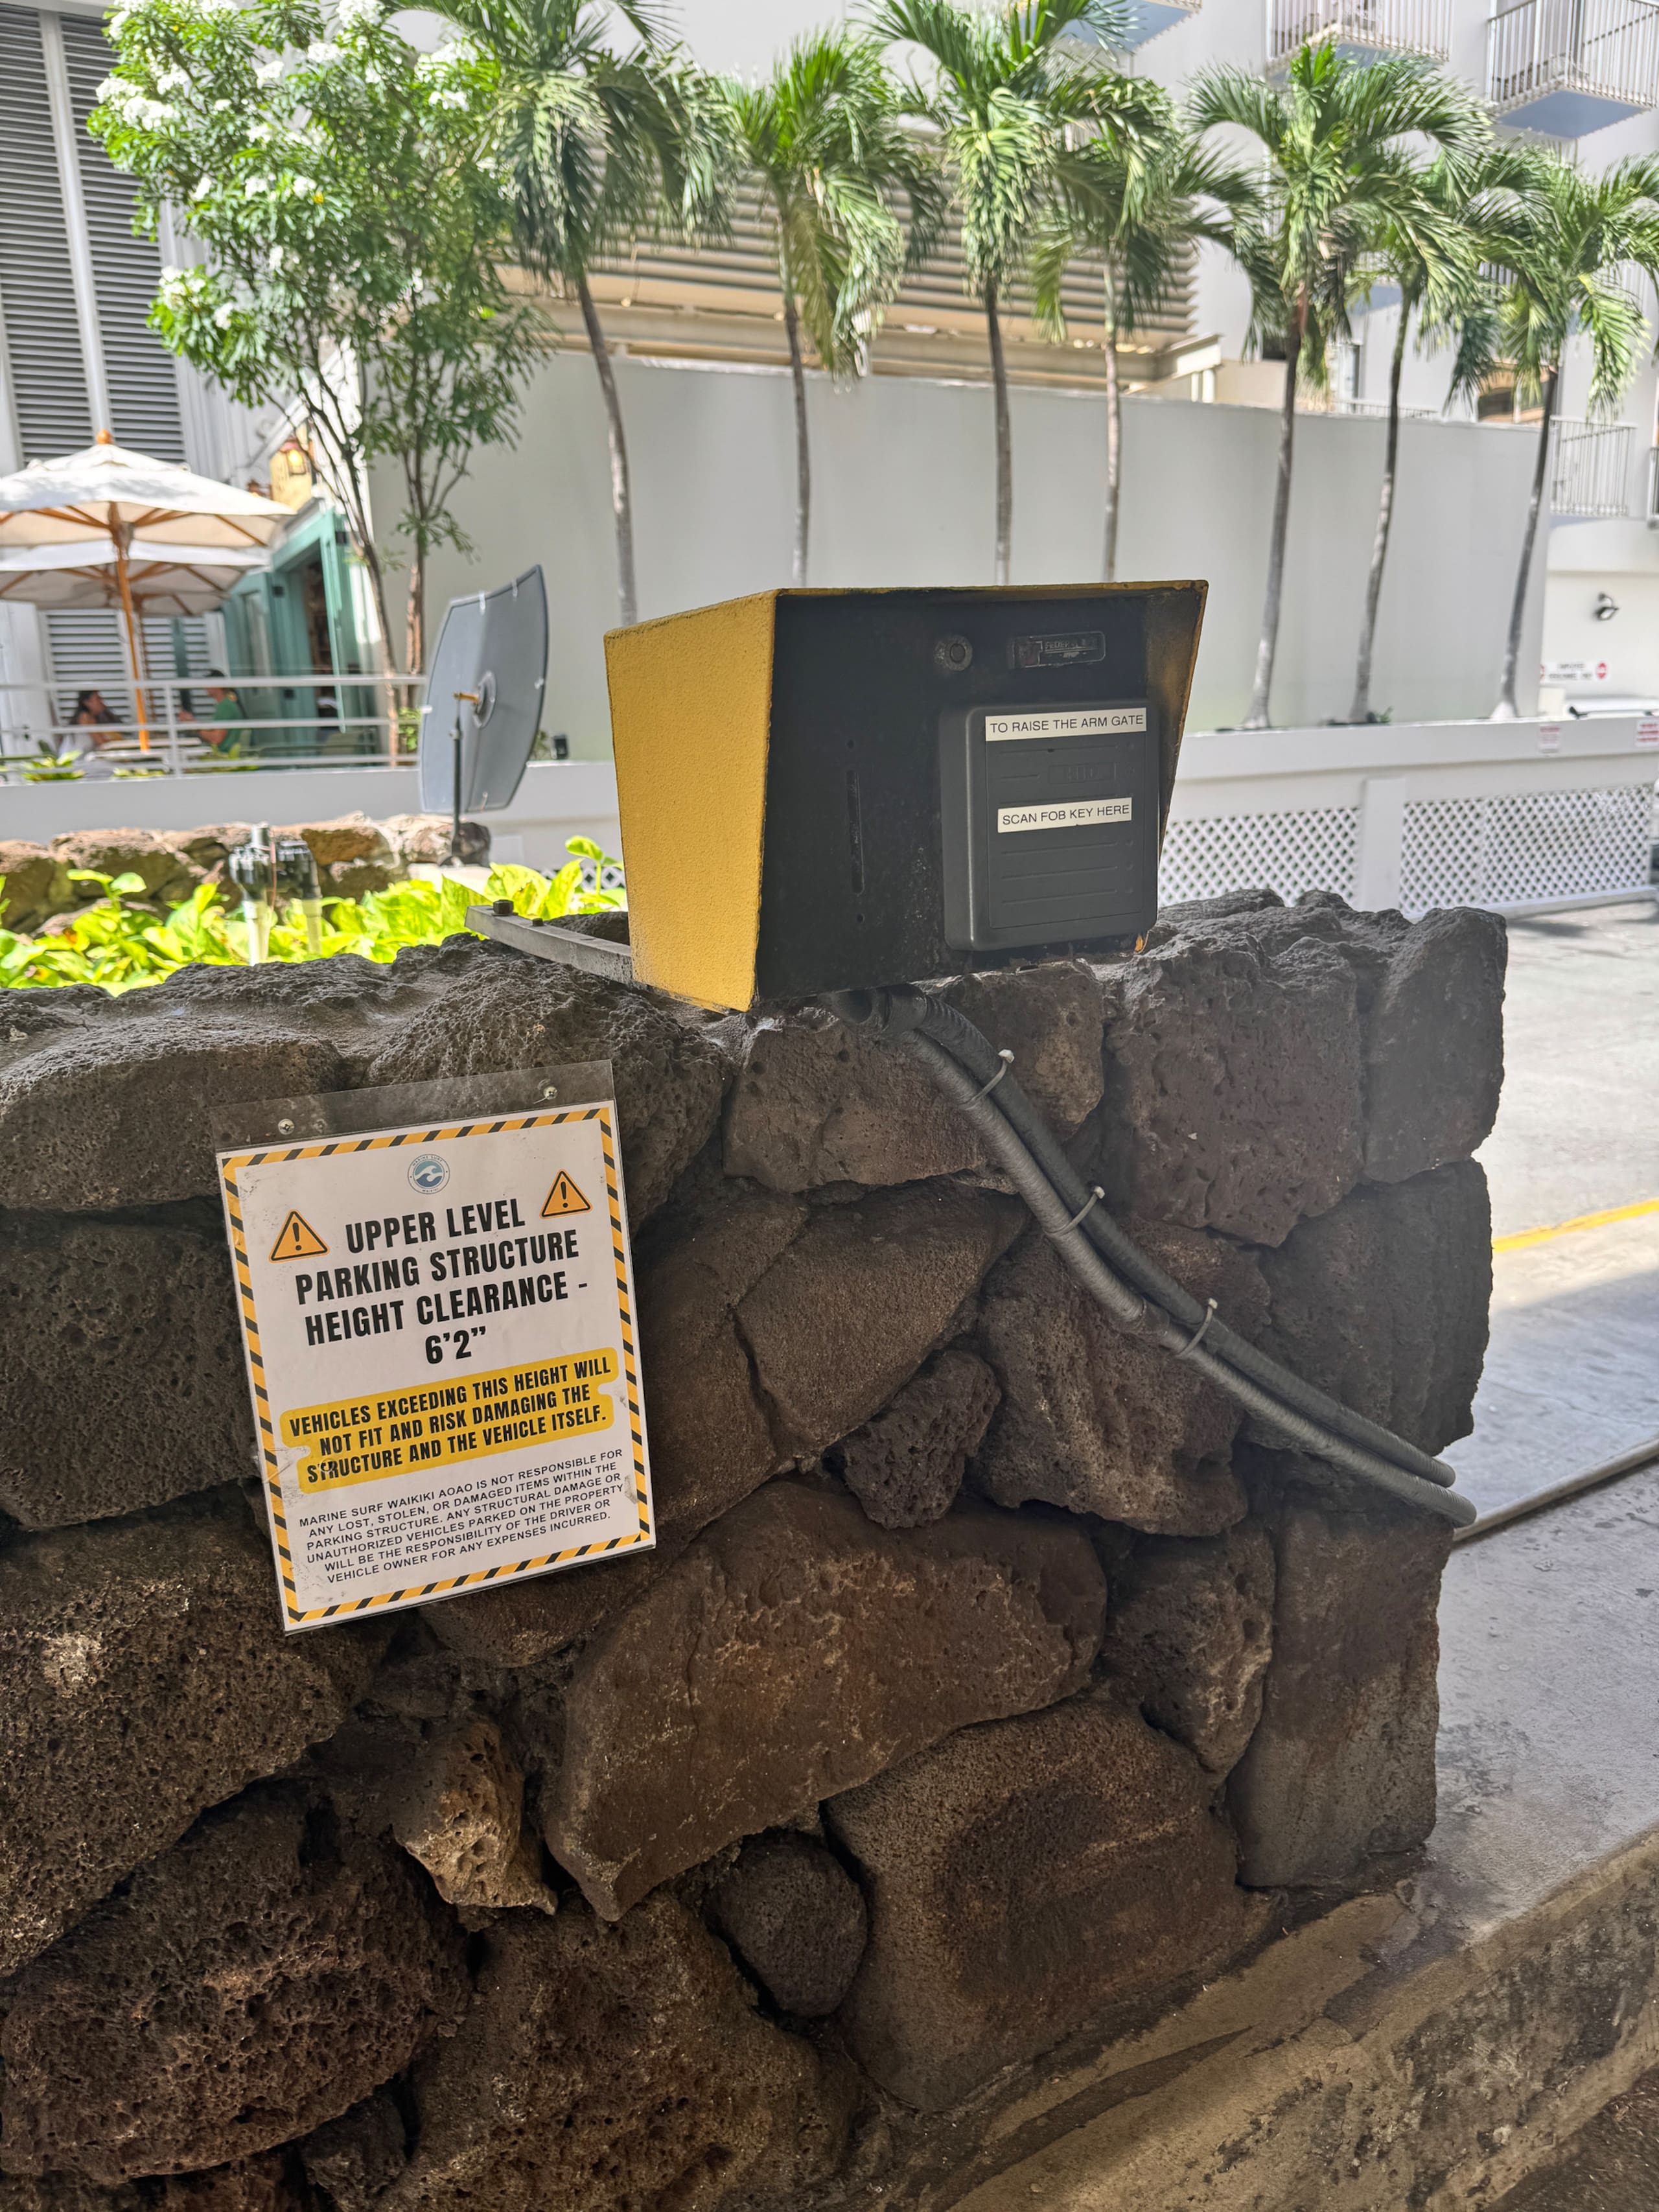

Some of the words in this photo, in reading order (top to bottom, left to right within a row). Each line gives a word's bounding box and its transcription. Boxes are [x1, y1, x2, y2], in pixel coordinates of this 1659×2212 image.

[990, 723, 1008, 733] TO
[1012, 720, 1049, 732] RAISE
[1052, 718, 1078, 730] THE
[1081, 717, 1108, 728] ARM
[1111, 714, 1144, 726] GATE
[1003, 812, 1037, 825] SCAN
[1040, 809, 1066, 821] FOB
[1069, 808, 1093, 819] KEY
[1097, 804, 1130, 817] HERE
[345, 1211, 437, 1253] UPPER
[445, 1198, 526, 1238] LEVEL
[295, 1255, 421, 1305] PARKING
[429, 1228, 579, 1282] STRUCTURE
[305, 1299, 404, 1346] HEIGHT
[415, 1270, 568, 1325] CLEARANCE
[289, 1404, 371, 1437] VEHICLES
[377, 1385, 467, 1421] EXCEEDING
[472, 1377, 509, 1401] THIS
[513, 1364, 568, 1392] HEIGHT
[573, 1356, 611, 1379] WILL
[319, 1432, 352, 1456] NOT
[358, 1426, 382, 1449] FIT
[389, 1419, 423, 1443] AND
[428, 1409, 467, 1434] RISK
[472, 1390, 557, 1425] DAMAGING
[561, 1383, 590, 1405] THE
[307, 1447, 403, 1484] STRUCTURE
[409, 1439, 442, 1463] AND
[447, 1431, 478, 1454] THE
[481, 1416, 547, 1446] VEHICLE
[551, 1404, 606, 1431] ITSELF.
[299, 1509, 347, 1527] MARINE
[351, 1502, 383, 1517] SURF
[387, 1491, 435, 1509] WAIKIKI
[438, 1483, 473, 1498] AOAO
[476, 1479, 487, 1489] IS
[491, 1473, 514, 1486] NOT
[518, 1454, 596, 1480] RESPONSIBLE
[599, 1449, 623, 1461] FOR
[307, 1531, 362, 1551] PARKING
[366, 1515, 443, 1538] STRUCTURE.
[446, 1508, 470, 1521] ANY
[474, 1489, 551, 1514] STRUCTURAL
[553, 1476, 602, 1495] DAMAGE
[605, 1473, 621, 1483] OR
[307, 1535, 402, 1563] UNAUTHORIZED
[406, 1521, 465, 1541] VEHICLES
[469, 1509, 516, 1528] PARKED
[519, 1504, 536, 1515] ON
[539, 1498, 561, 1510] THE
[564, 1484, 623, 1504] PROPERTY
[308, 1524, 334, 1538] ANY
[338, 1517, 374, 1531] LOST,
[377, 1506, 429, 1524] STOLEN,
[432, 1500, 450, 1511] OR
[454, 1486, 512, 1507] DAMAGED
[515, 1477, 550, 1493] ITEMS
[552, 1467, 592, 1484] WITHIN
[594, 1461, 616, 1473] THE
[324, 1558, 354, 1572] WILL
[358, 1553, 374, 1565] BE
[377, 1547, 402, 1559] THE
[405, 1524, 502, 1554] RESPONSIBILITY
[505, 1519, 520, 1531] OF
[524, 1513, 546, 1526] THE
[550, 1503, 591, 1520] DRIVER
[594, 1498, 610, 1509] OR
[327, 1564, 380, 1583] VEHICLE
[383, 1554, 428, 1570] OWNER
[431, 1548, 456, 1561] FOR
[459, 1540, 483, 1554] ANY
[486, 1525, 547, 1547] EXPENSES
[550, 1511, 610, 1532] INCURRED.
